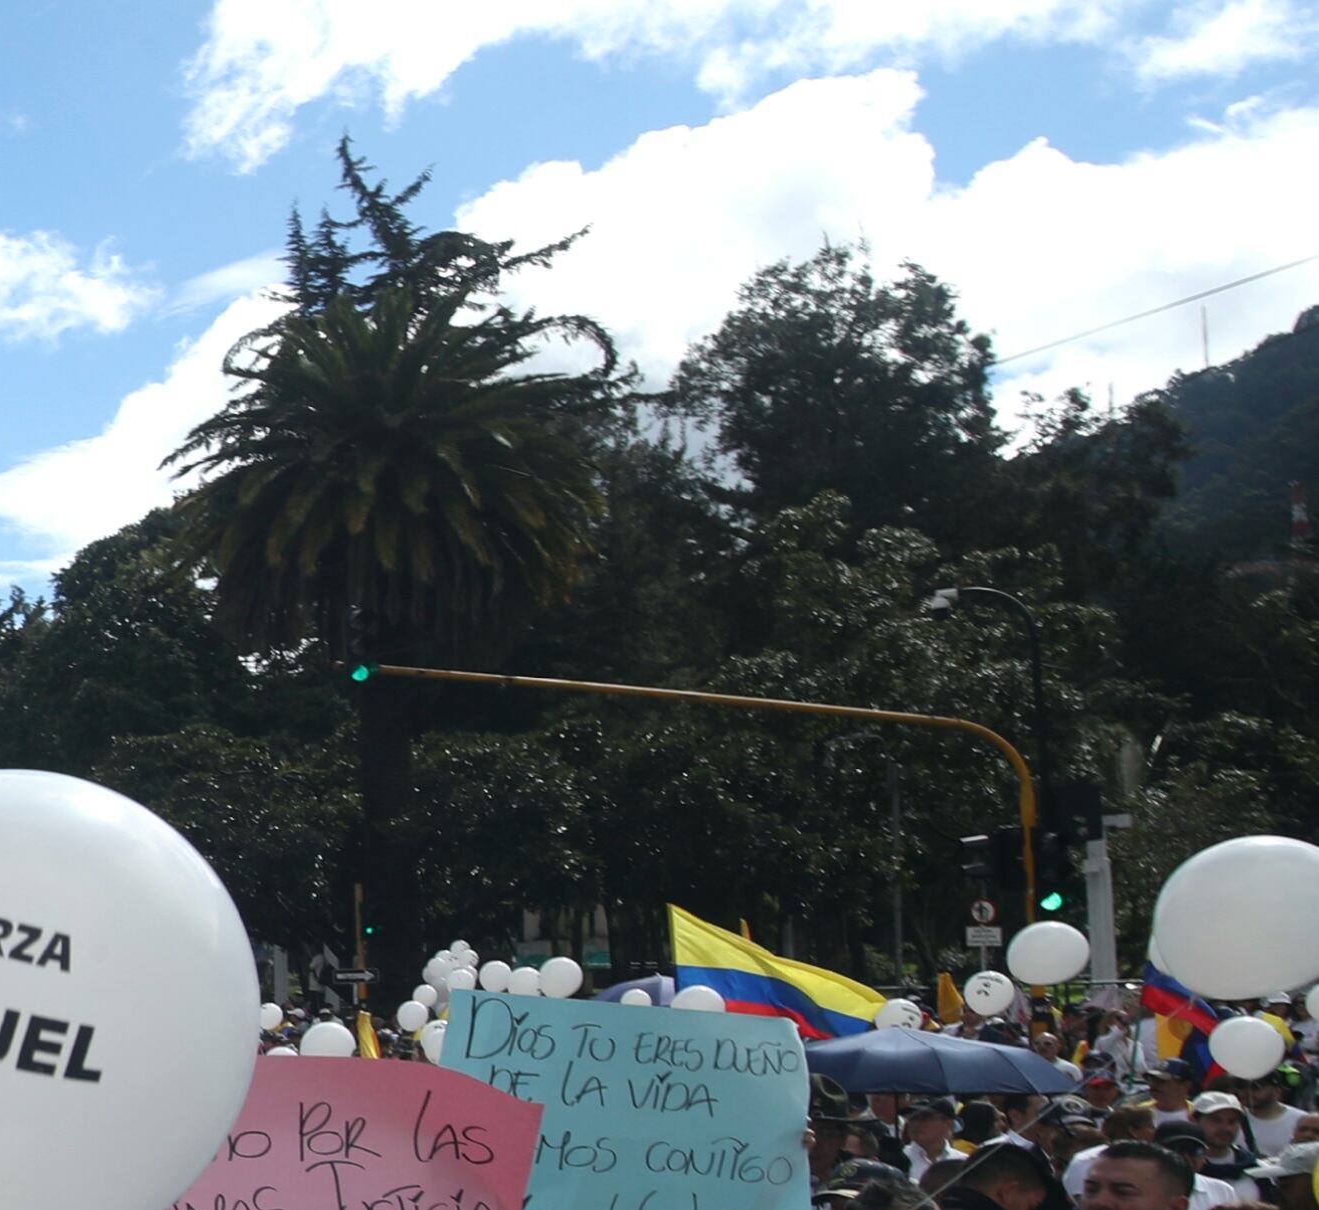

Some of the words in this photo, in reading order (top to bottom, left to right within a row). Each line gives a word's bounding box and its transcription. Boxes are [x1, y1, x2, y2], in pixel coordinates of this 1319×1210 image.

[571, 1023, 615, 1061] TU
[635, 1032, 704, 1072] ERES
[713, 1038, 799, 1077] DUEÑO
[535, 1130, 617, 1173] MOS
